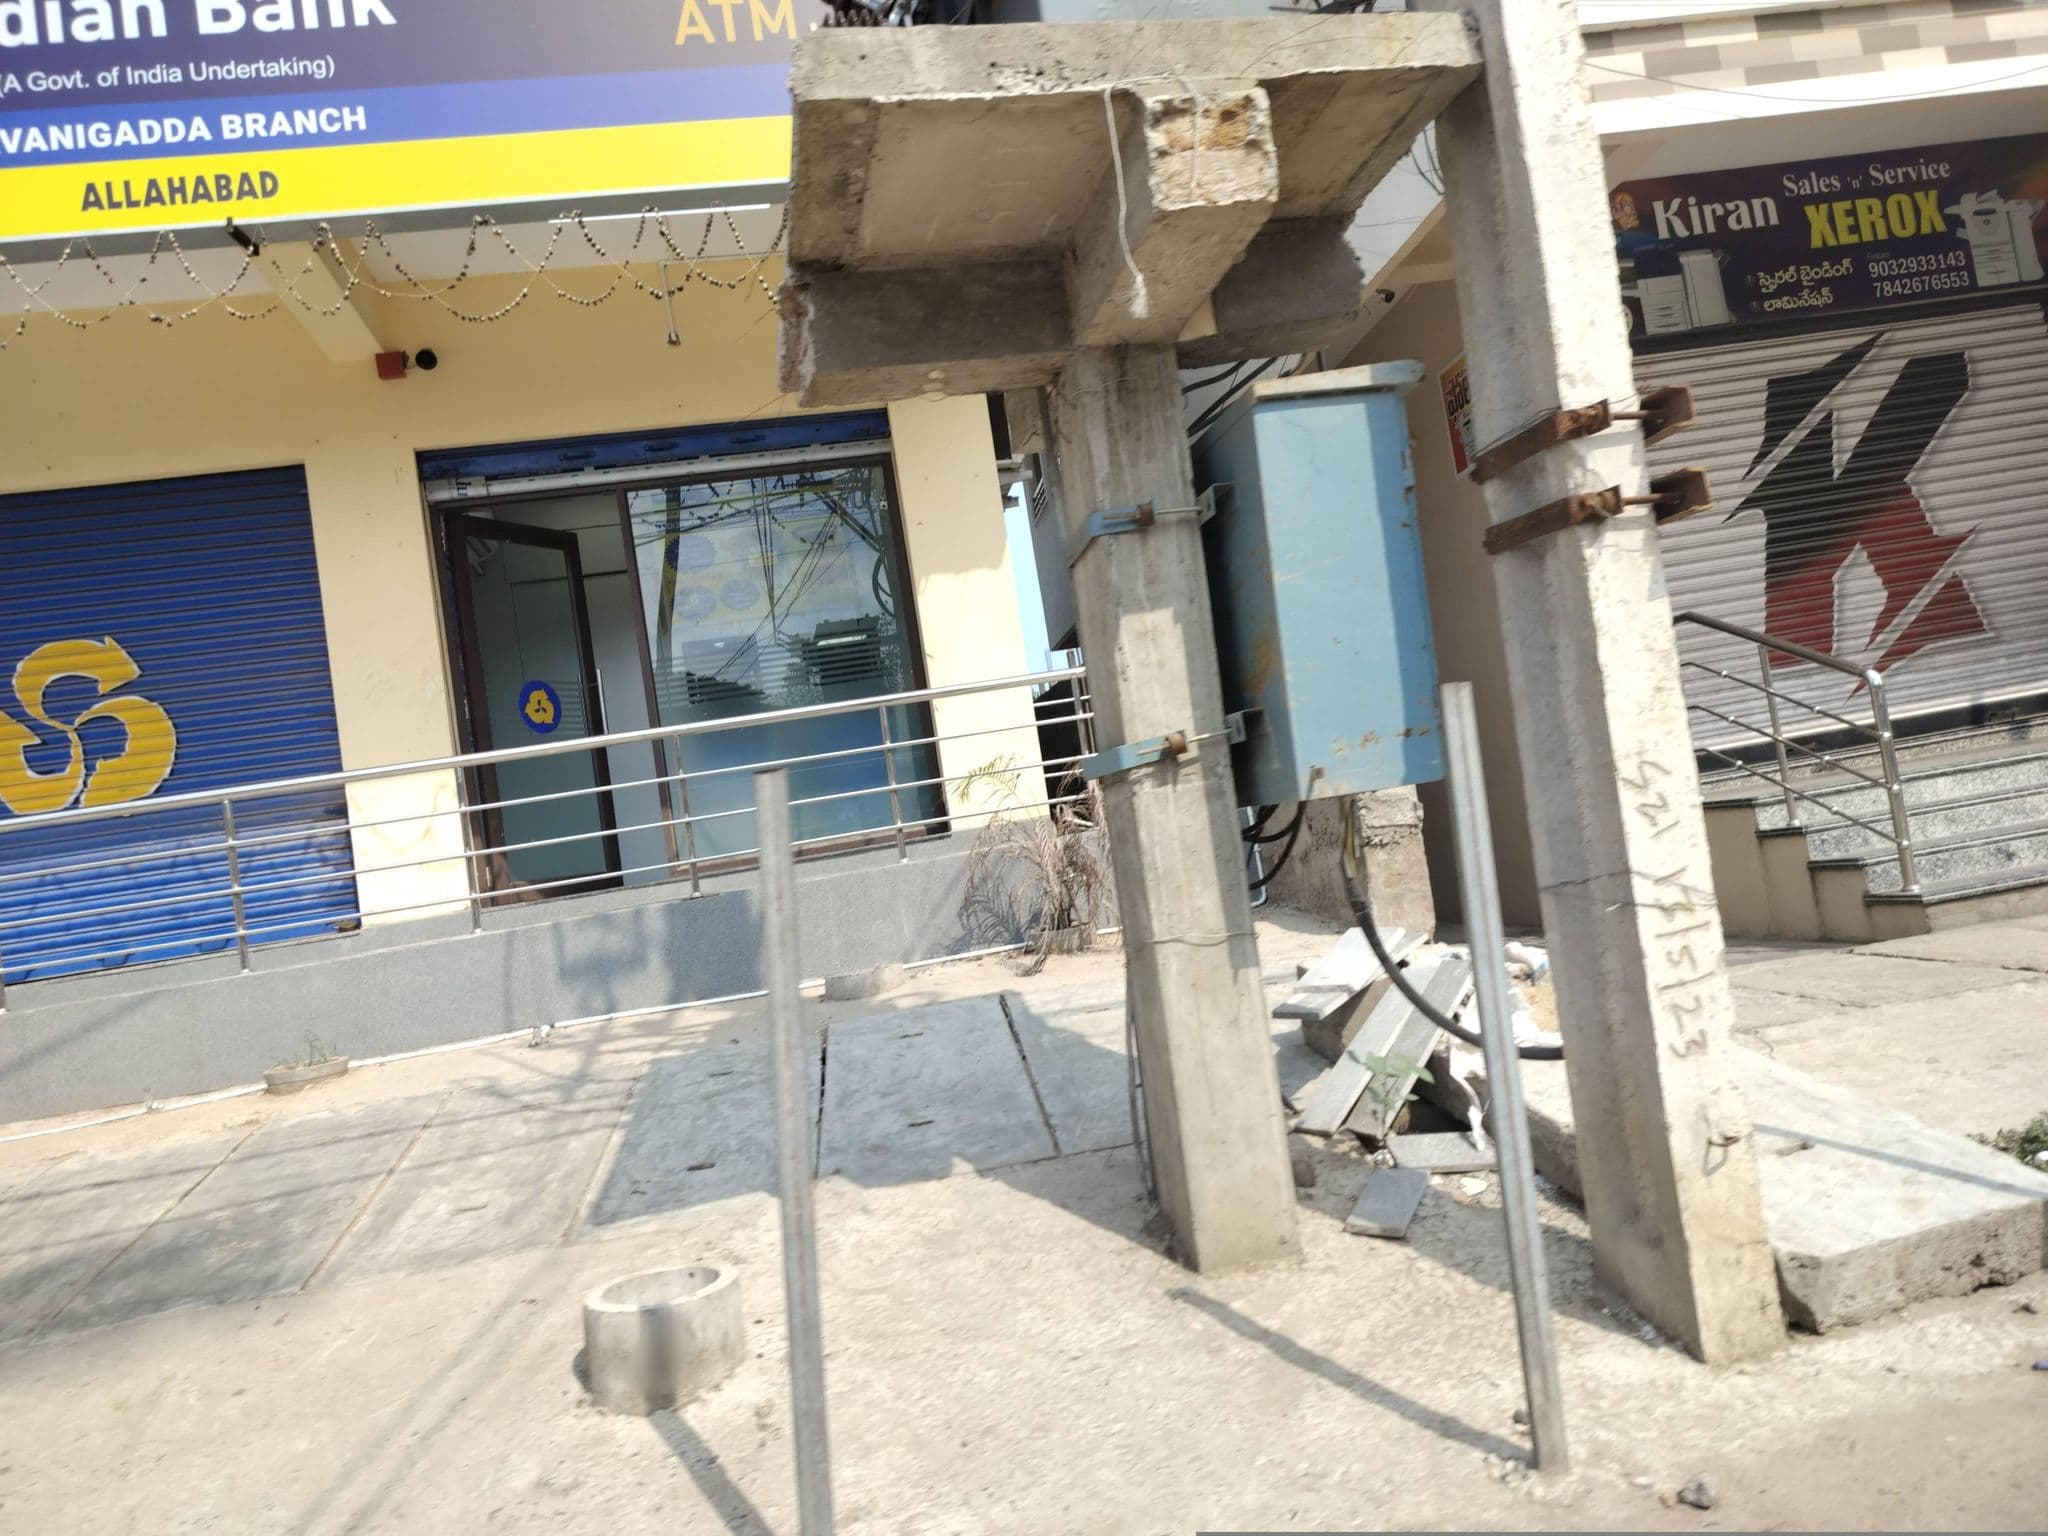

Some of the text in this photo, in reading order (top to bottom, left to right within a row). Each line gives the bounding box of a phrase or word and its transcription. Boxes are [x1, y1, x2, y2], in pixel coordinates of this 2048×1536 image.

[675, 0, 798, 45] ATM
[27, 70, 90, 92] Govt.
[97, 66, 120, 87] of
[126, 62, 183, 86] India
[189, 54, 335, 82] Undertaking)
[220, 105, 367, 141] BRANCH
[81, 170, 280, 212] ALLAHABAD
[1782, 173, 1841, 197] Sales
[1868, 157, 1951, 187] Service
[1652, 196, 1780, 240] Kiran
[1804, 189, 1948, 249] XEROX
[1868, 250, 1966, 278] 9032933143
[1873, 271, 1970, 298] 7842676553
